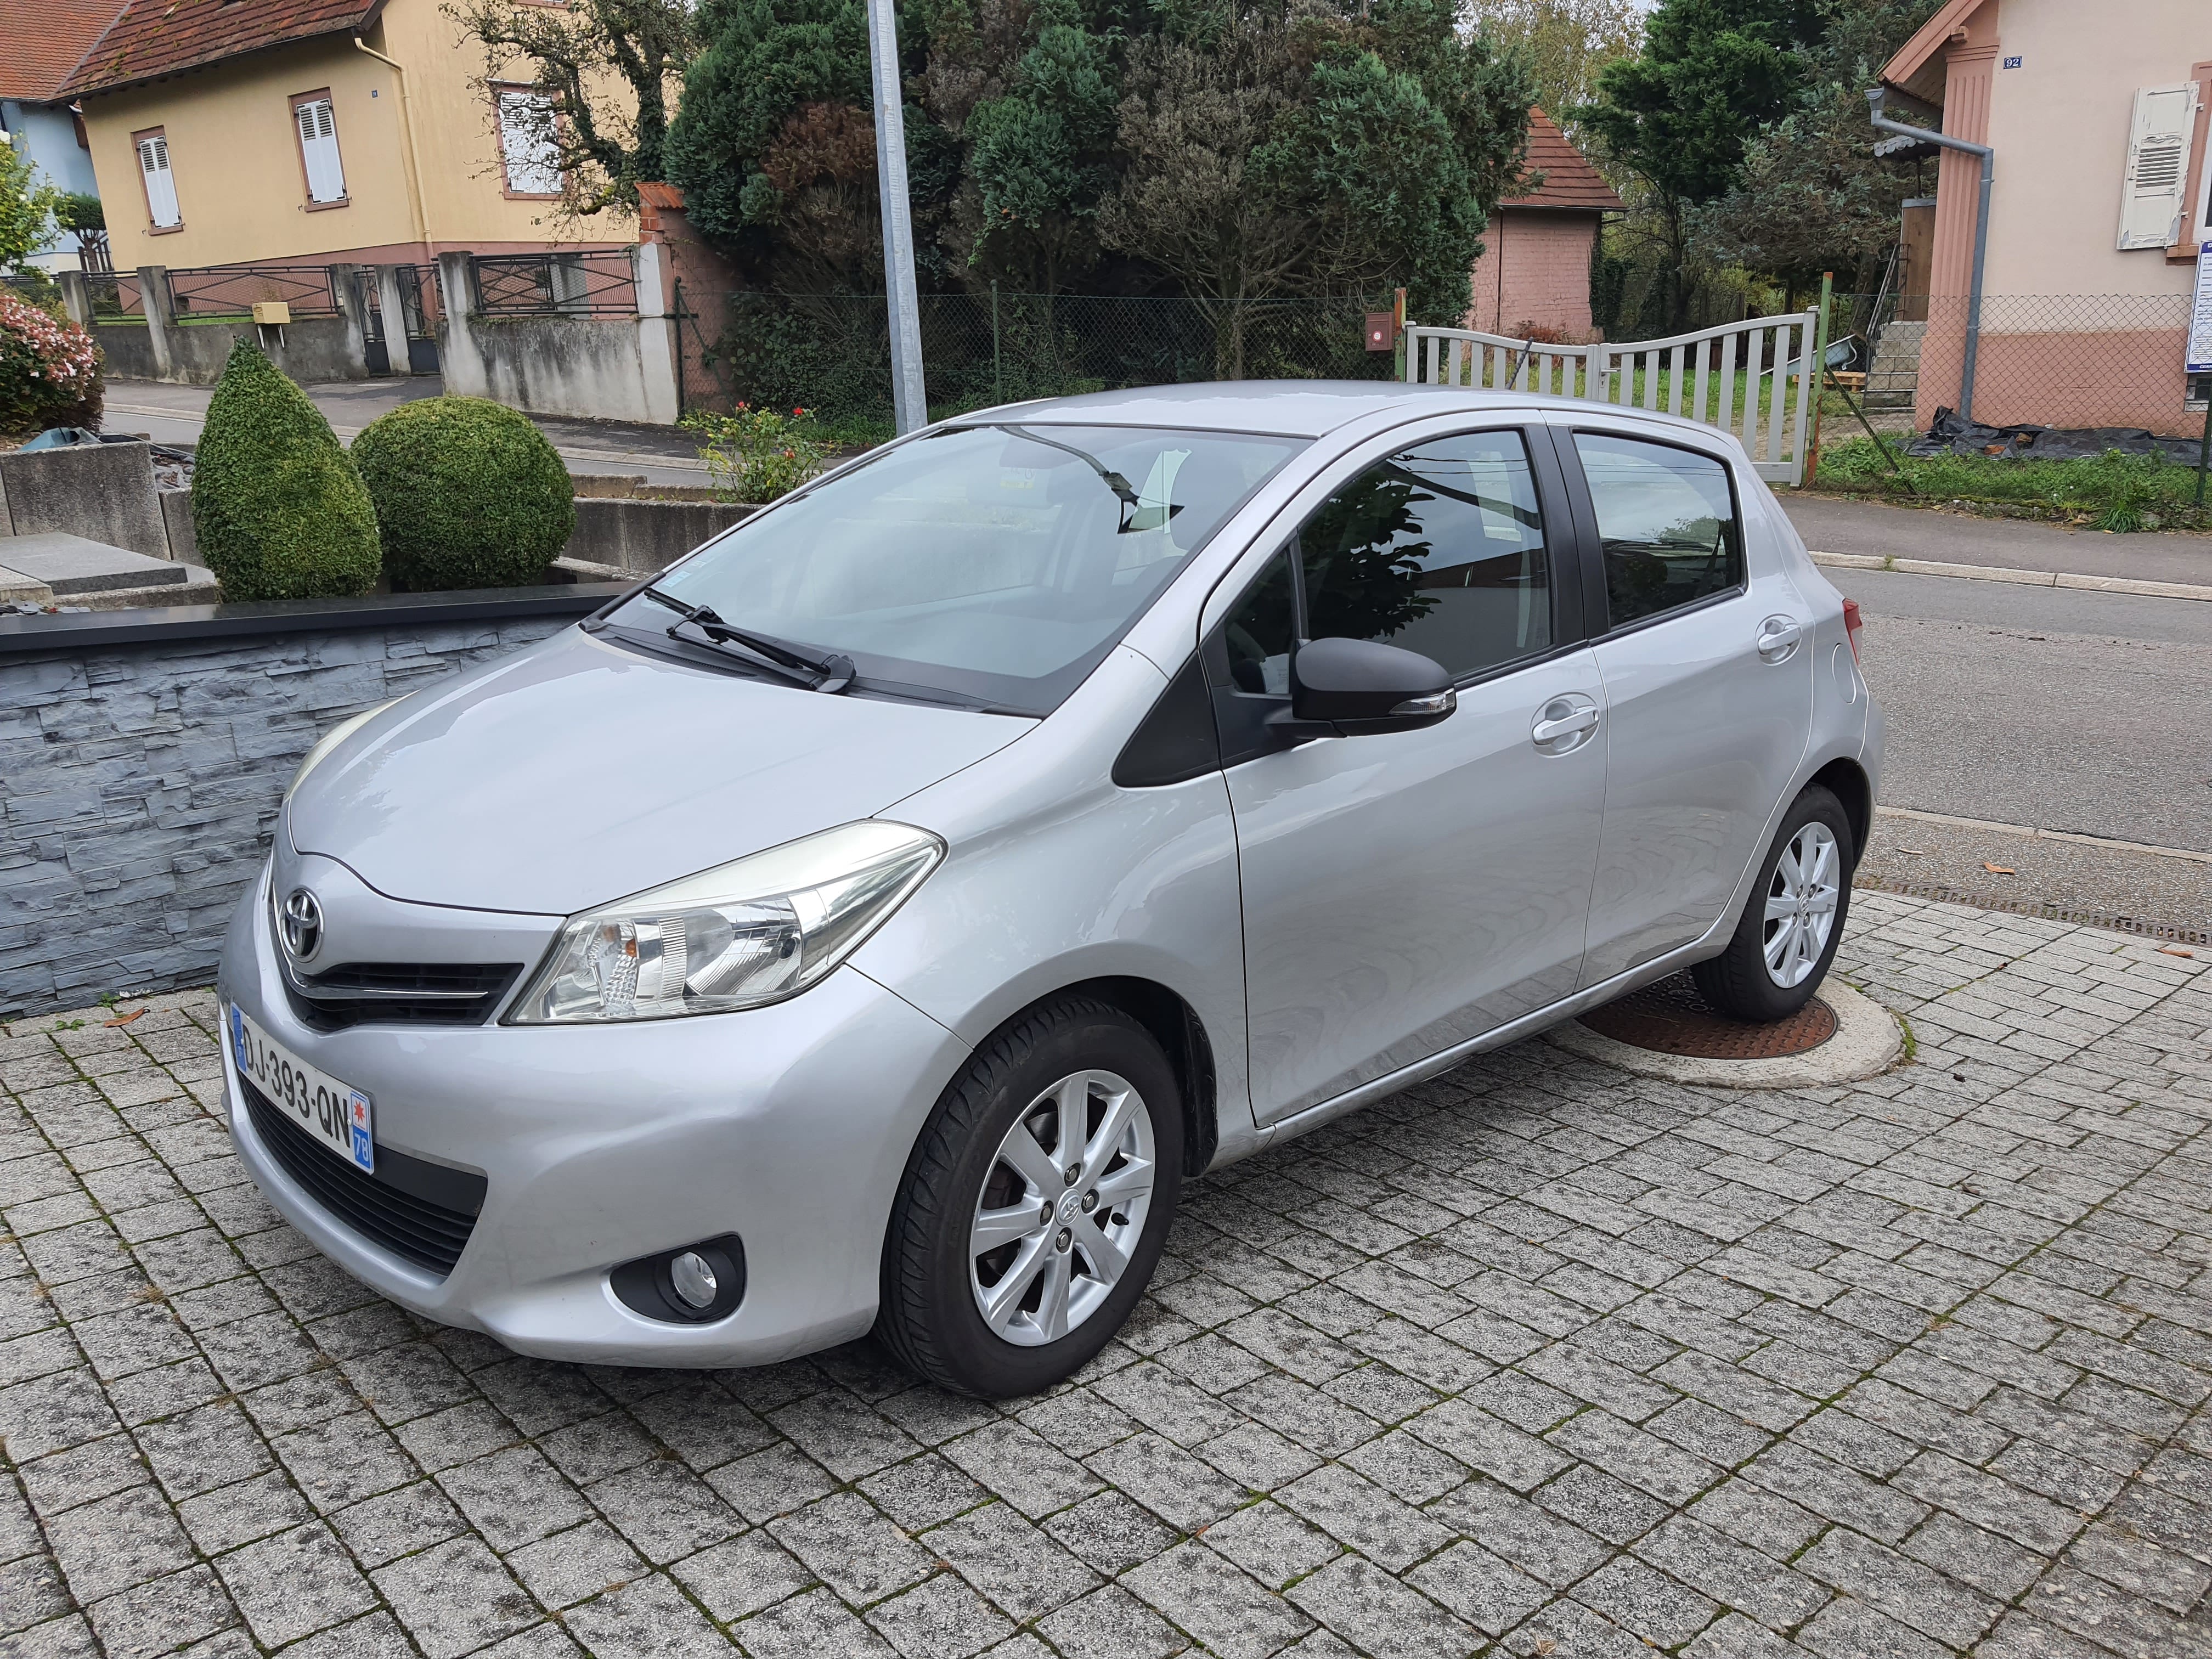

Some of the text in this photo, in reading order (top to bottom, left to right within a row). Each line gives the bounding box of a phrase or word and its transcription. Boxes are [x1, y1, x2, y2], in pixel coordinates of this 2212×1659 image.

[2006, 58, 2019, 67] 92
[243, 1023, 350, 1148] DJ-393-QN
[354, 1133, 369, 1162] 78
